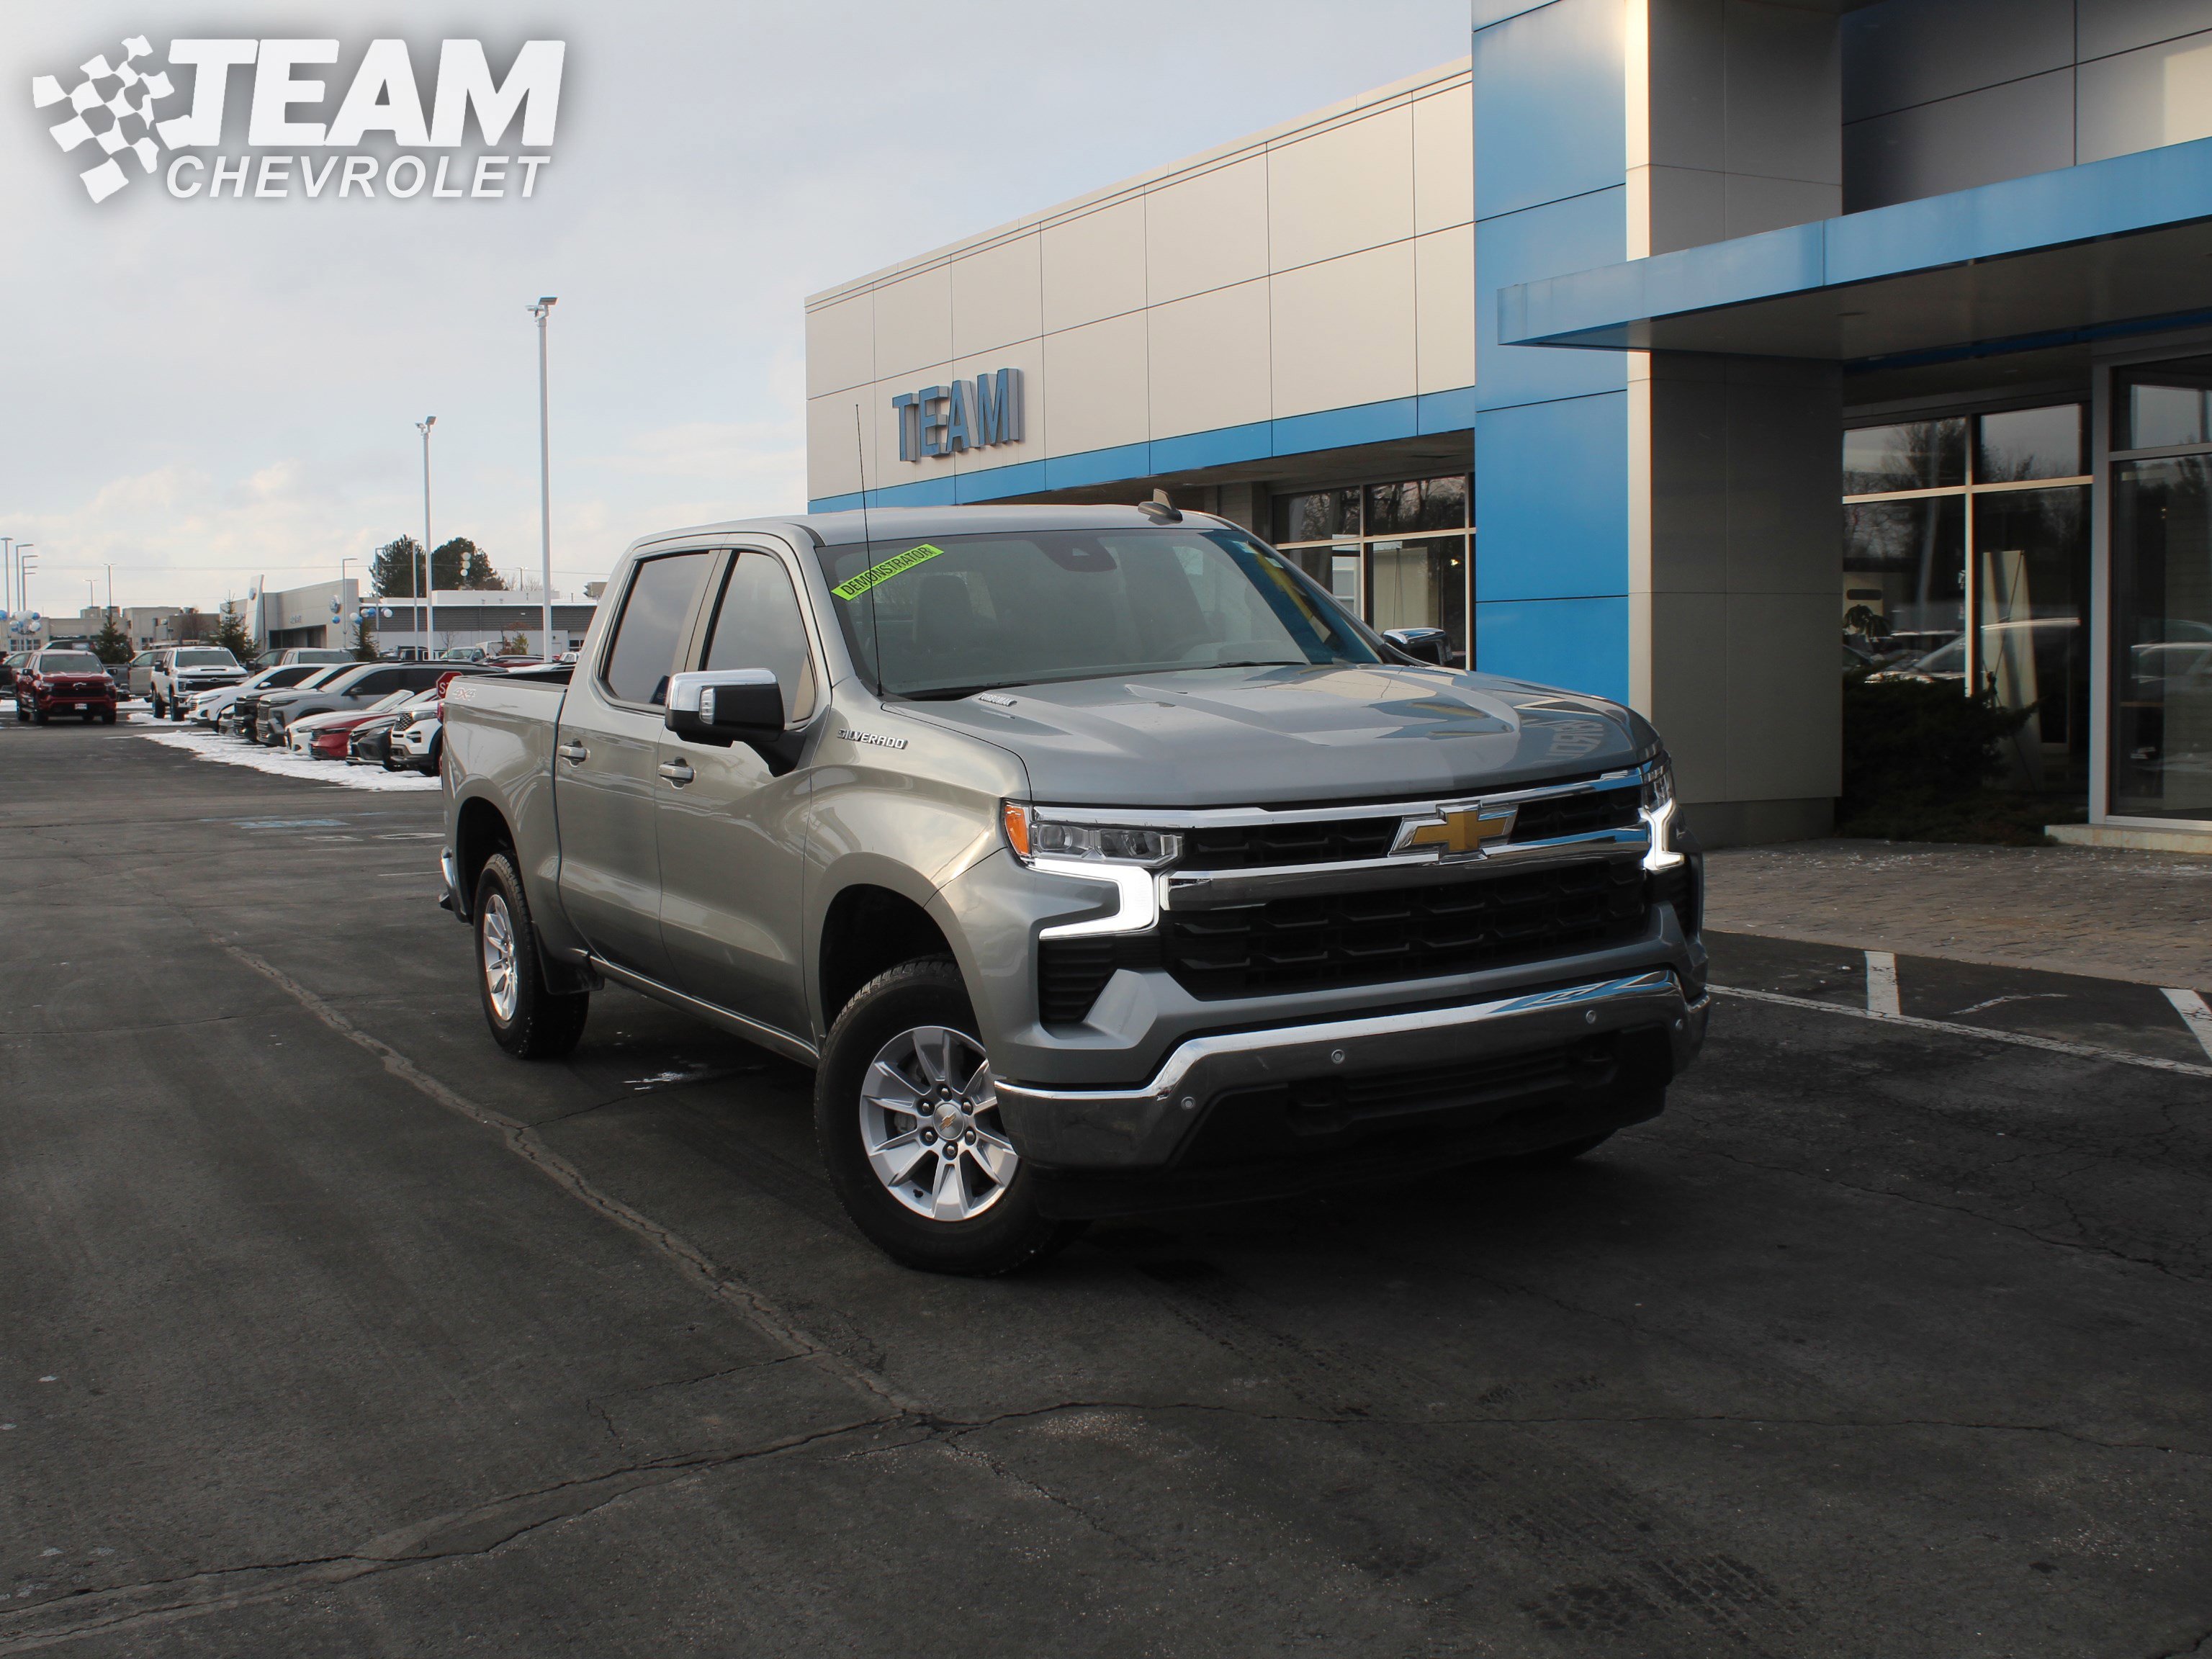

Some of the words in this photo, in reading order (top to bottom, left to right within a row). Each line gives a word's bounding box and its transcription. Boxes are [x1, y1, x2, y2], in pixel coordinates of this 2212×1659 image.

[892, 368, 1019, 462] TEAM
[840, 547, 934, 595] DEMONSTRATOR
[837, 728, 908, 750] SILVERADO
